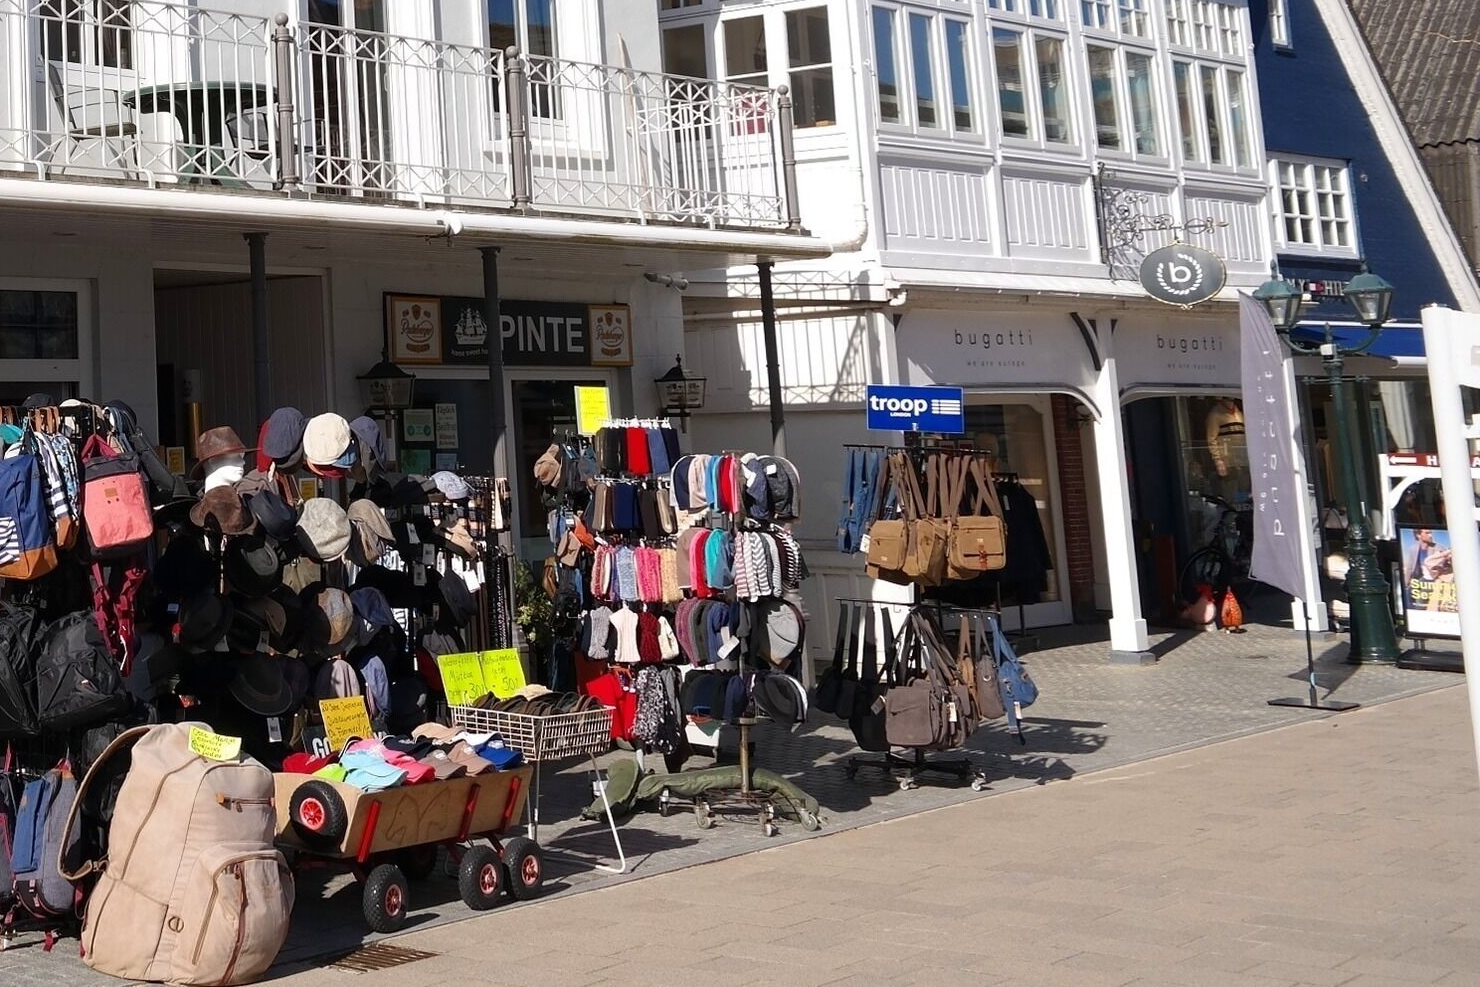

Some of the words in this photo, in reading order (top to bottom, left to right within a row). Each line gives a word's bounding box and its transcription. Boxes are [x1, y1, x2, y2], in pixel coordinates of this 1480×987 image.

[499, 315, 584, 352] PINTE
[954, 328, 1032, 349] bugatti
[1156, 334, 1222, 353] bugatti
[870, 395, 928, 417] troop
